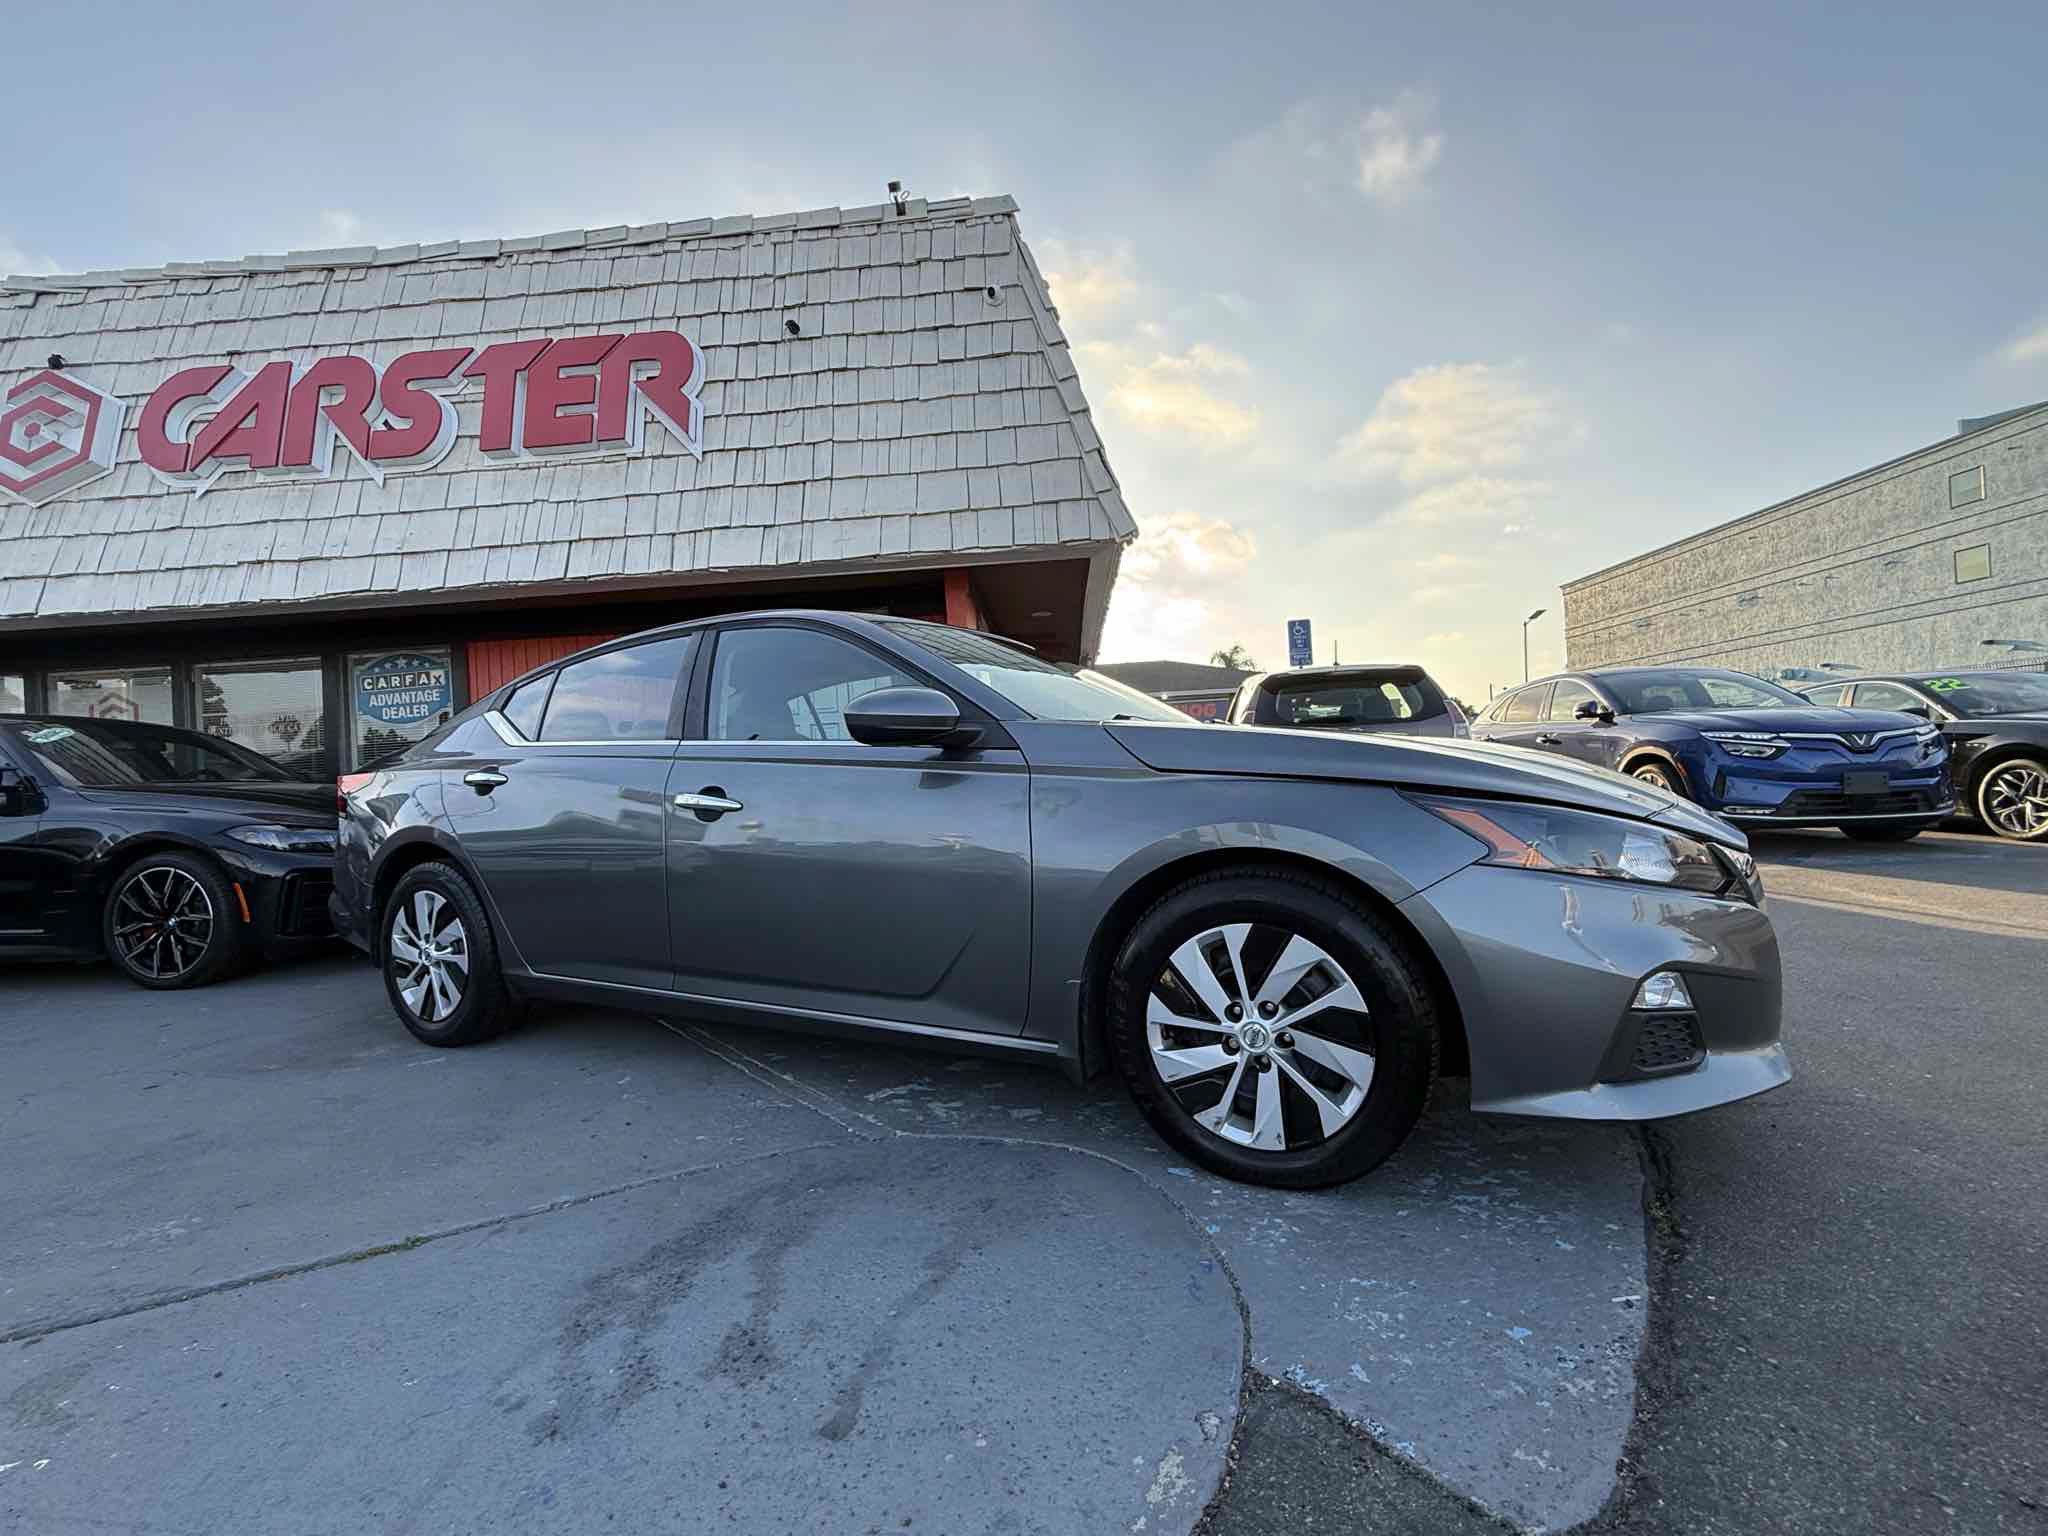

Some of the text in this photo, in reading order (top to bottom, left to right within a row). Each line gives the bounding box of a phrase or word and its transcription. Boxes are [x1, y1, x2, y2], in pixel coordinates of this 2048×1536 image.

[137, 331, 697, 474] CARSTER
[362, 672, 443, 690] CARFAX
[369, 689, 441, 707] ADVANTAGE
[382, 705, 430, 720] DEALER
